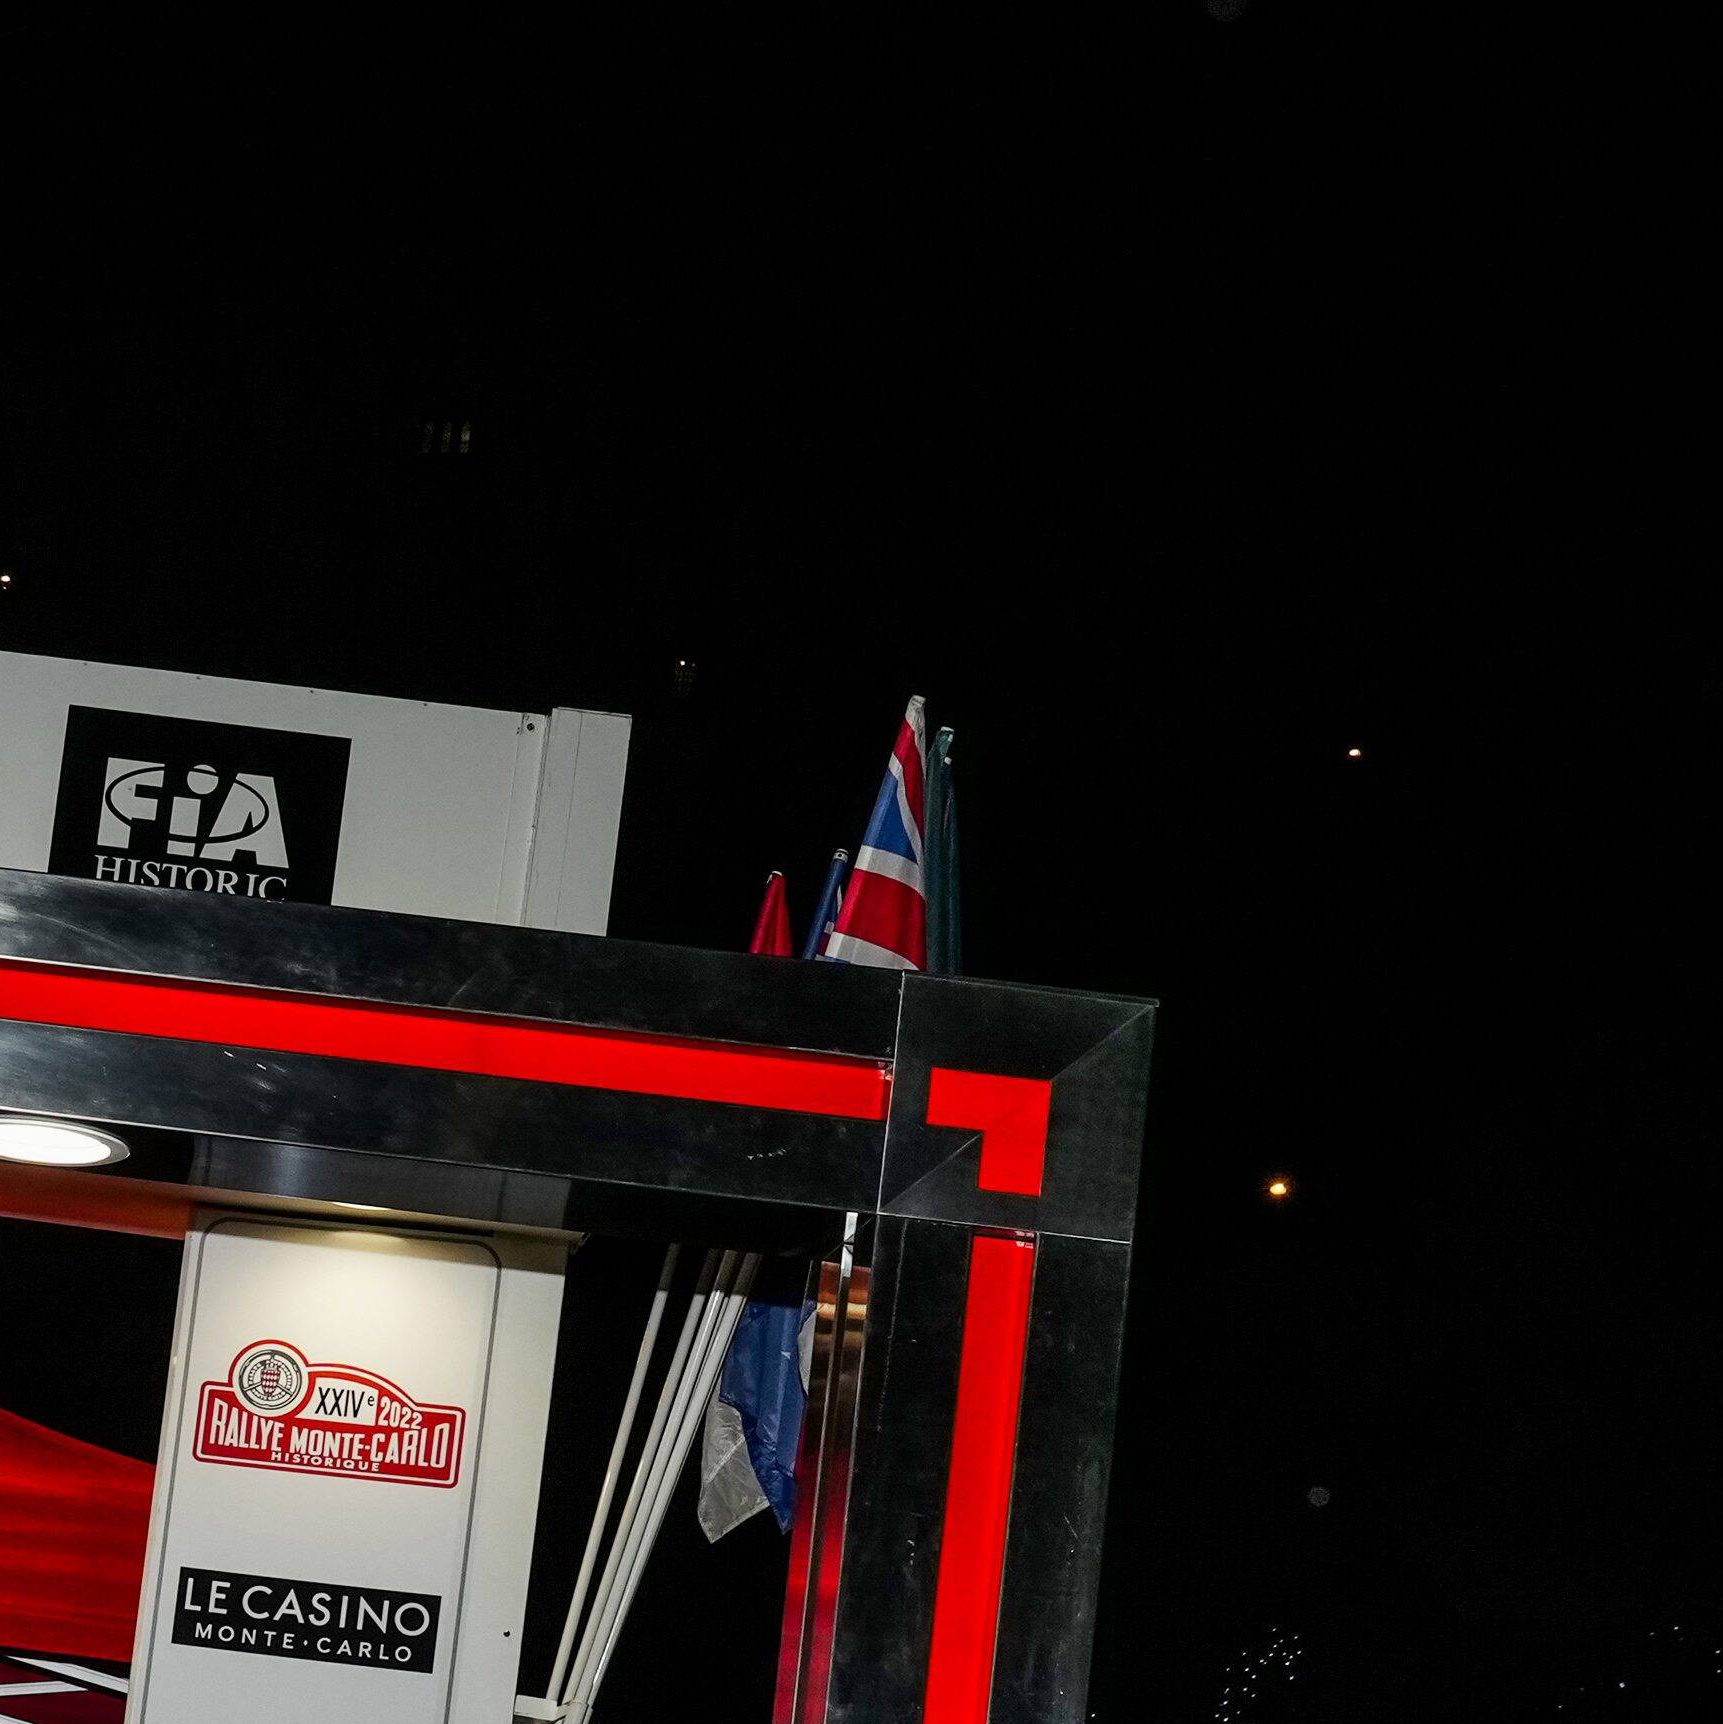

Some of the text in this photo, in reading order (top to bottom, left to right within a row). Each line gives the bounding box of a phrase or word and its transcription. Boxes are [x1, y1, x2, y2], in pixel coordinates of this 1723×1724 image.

[94, 854, 288, 904] HISTORIC
[209, 1397, 450, 1469] RALLYE MONTE-CARLO
[377, 1395, 423, 1430] 2022
[270, 1450, 380, 1473] HISTORIQUE
[183, 1577, 431, 1637] LE CASINO
